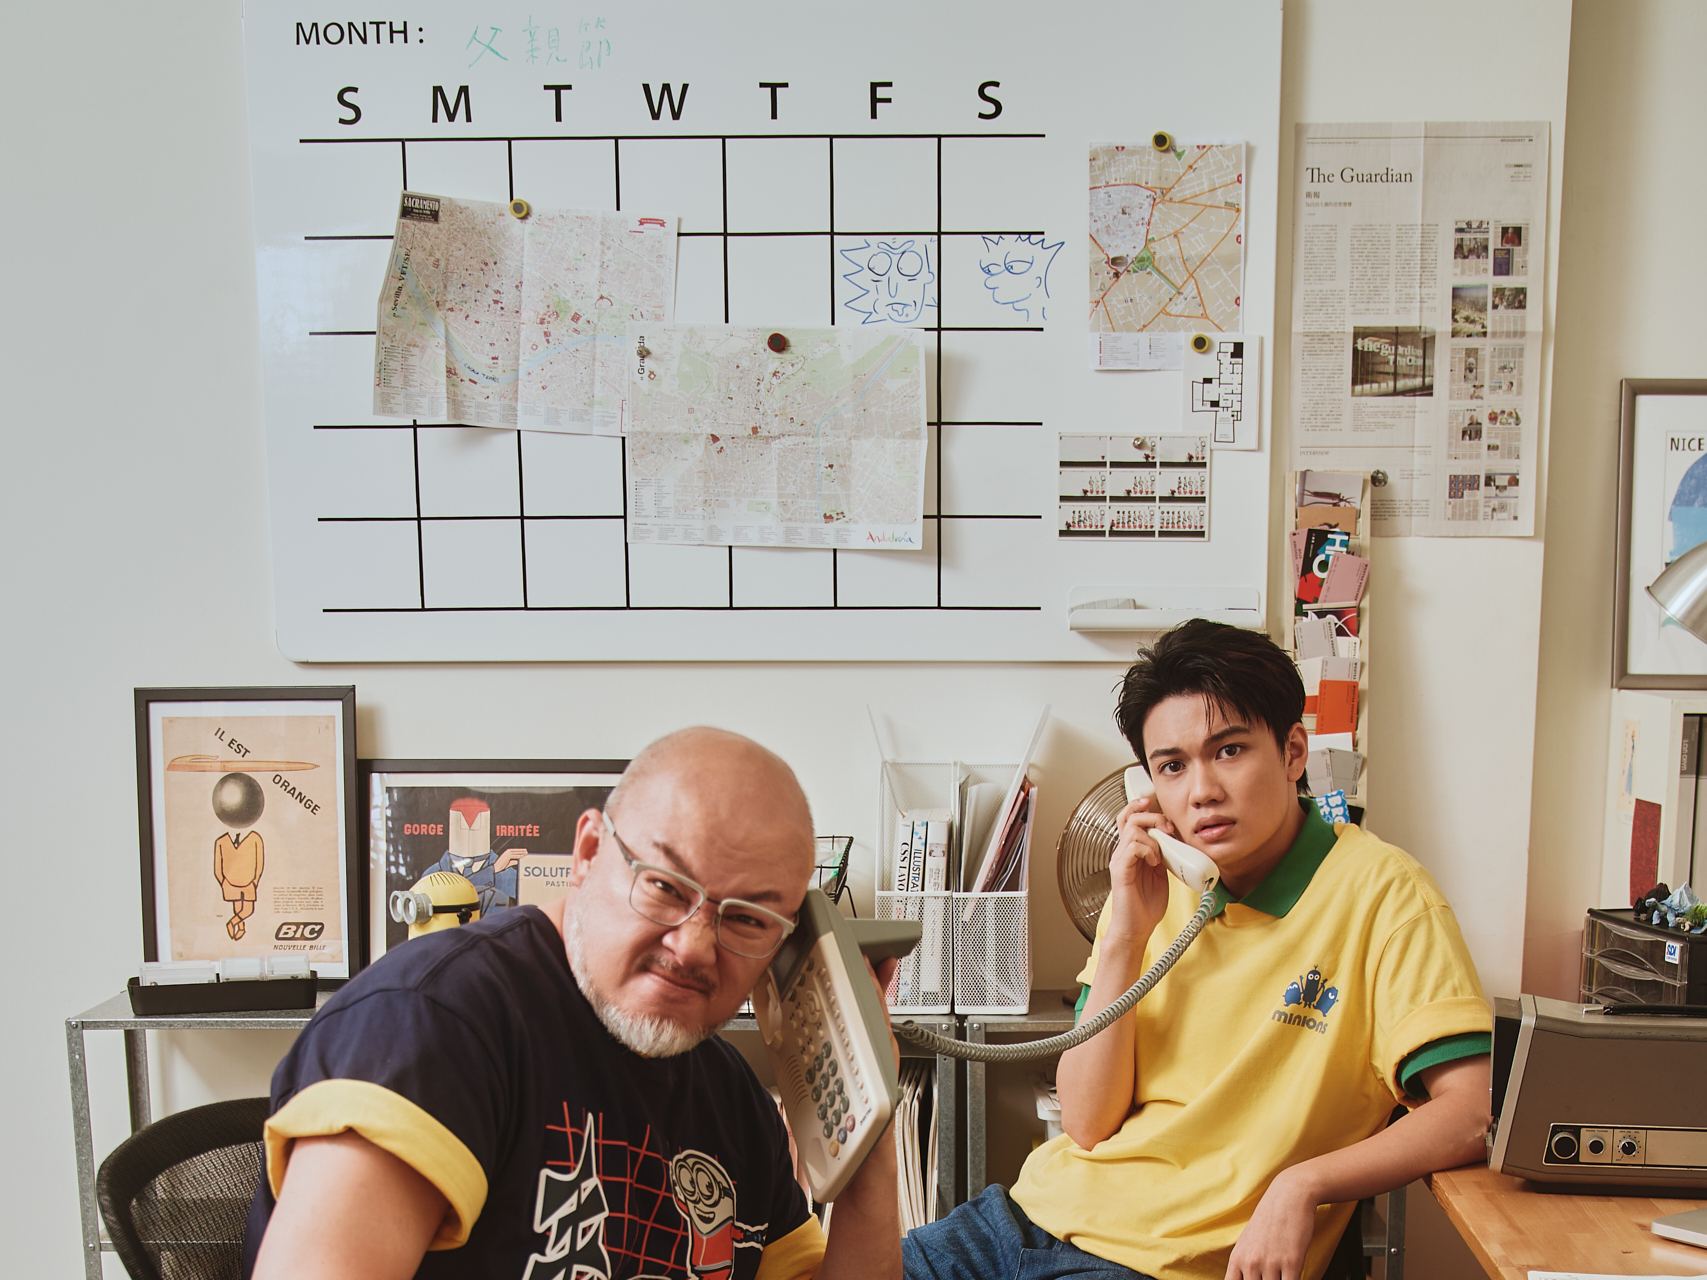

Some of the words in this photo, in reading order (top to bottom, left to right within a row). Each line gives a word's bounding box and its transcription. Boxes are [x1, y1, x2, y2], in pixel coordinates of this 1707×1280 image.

[336, 85, 362, 126] S
[431, 84, 473, 124] M
[542, 84, 573, 123] T
[641, 82, 690, 122] W
[758, 82, 789, 121] T
[868, 81, 894, 120] F
[976, 80, 1004, 121] S
[1305, 166, 1335, 184] The
[1339, 166, 1414, 184] Guardian
[403, 195, 440, 212] SACRAMENTO
[637, 335, 646, 375] Grada
[1669, 437, 1705, 452] NICE
[865, 531, 916, 545] Andalucía
[213, 726, 226, 742] IL
[227, 737, 251, 759] EST
[272, 773, 321, 816] ORANGE
[403, 823, 444, 836] GORGE
[495, 823, 540, 837] IRRITÉE
[899, 841, 910, 862] CSS
[1271, 1009, 1328, 1035] minions
